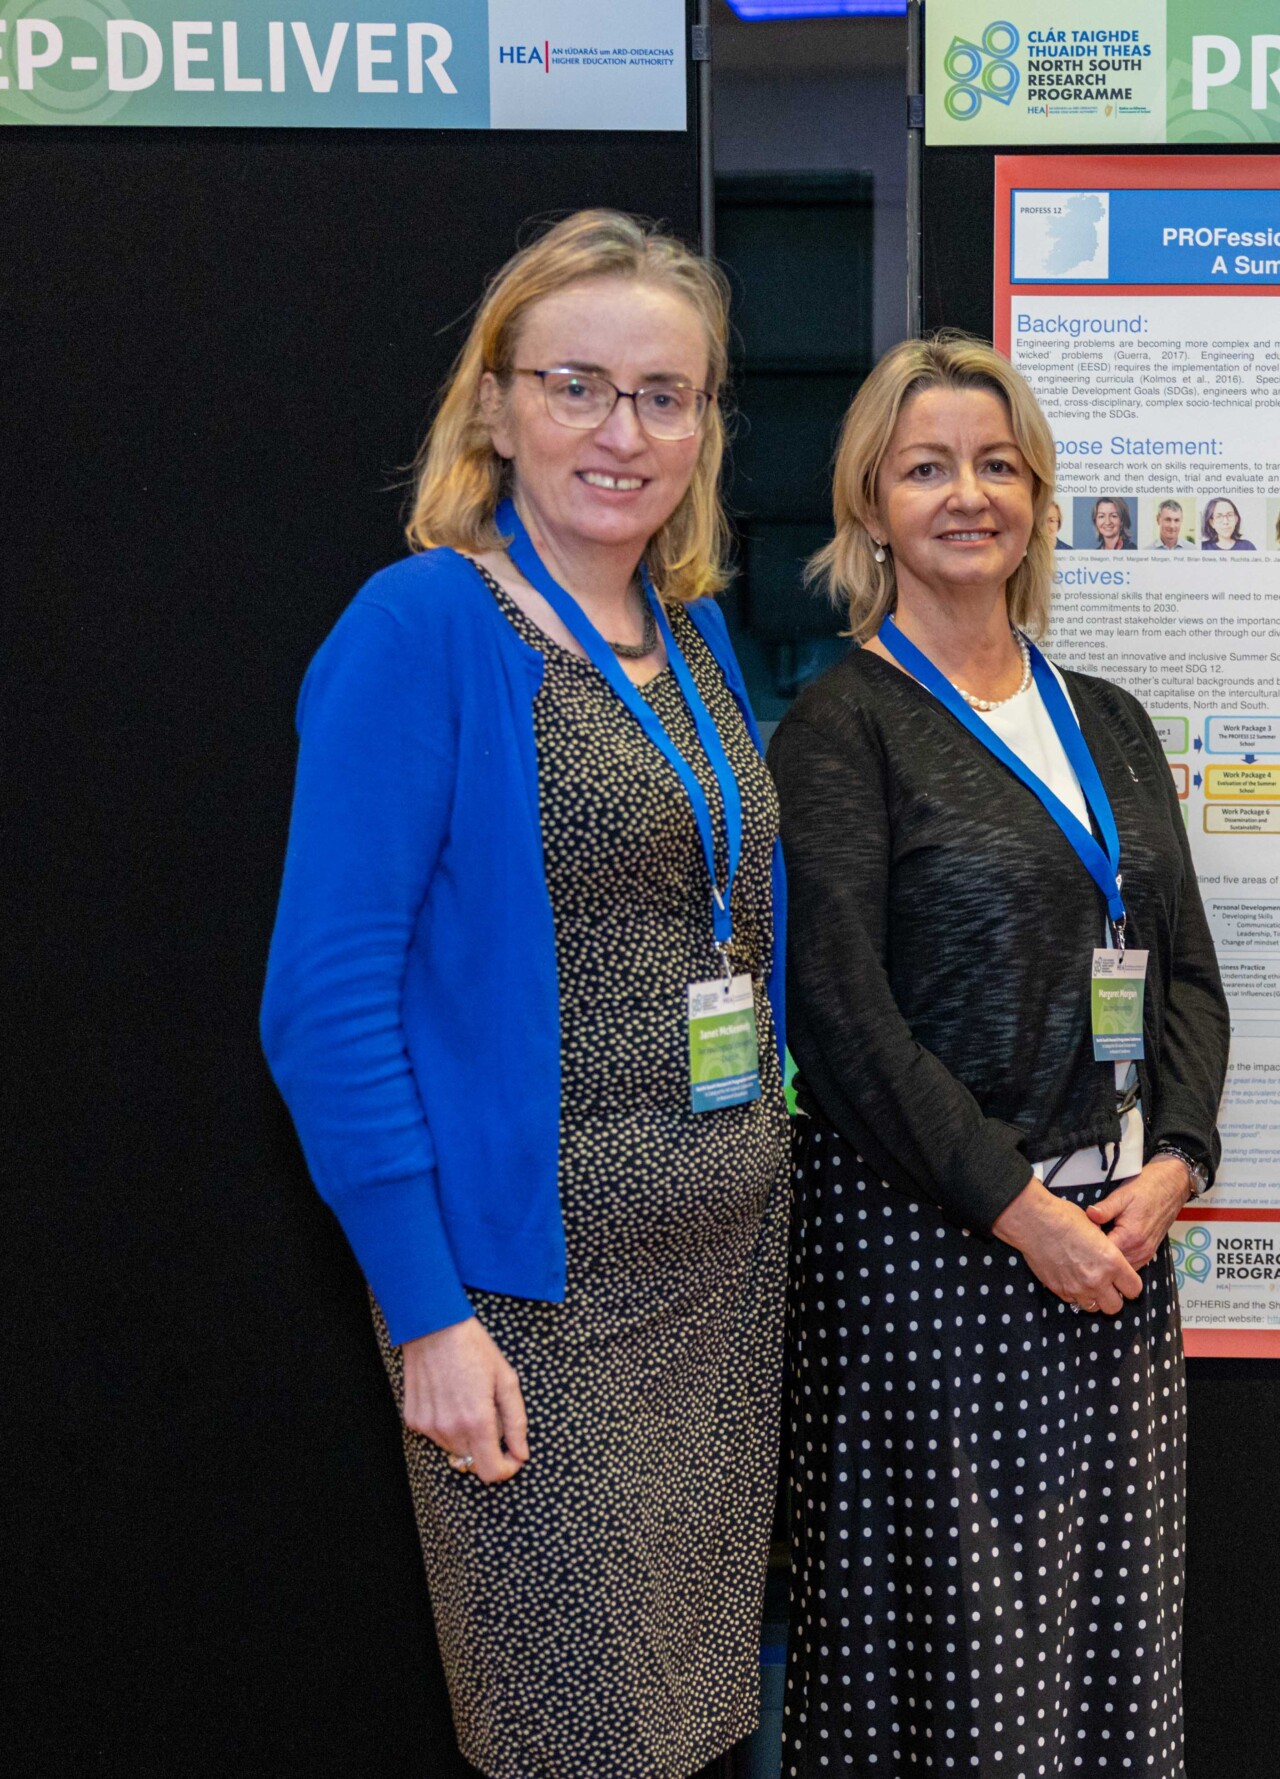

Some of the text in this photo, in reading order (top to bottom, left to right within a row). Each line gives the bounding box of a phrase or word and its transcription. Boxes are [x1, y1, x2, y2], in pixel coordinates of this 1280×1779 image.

[1027, 27, 1139, 42] CLÁR TAIGHDE
[500, 46, 543, 64] HEA
[552, 48, 564, 56] AN
[565, 46, 598, 56] tÚDARÁS
[612, 48, 674, 56] ARD-OIDEACHAS
[1028, 45, 1151, 57] THUAIDH THEAS
[582, 58, 626, 66] EDUCATION
[630, 58, 674, 66] AUTHORITY
[1028, 59, 1141, 71] NORTH SOUTH
[1028, 74, 1105, 86] RESEARCH
[1028, 88, 1131, 100] PROGRAMME
[1027, 106, 1045, 114] HEA
[1212, 256, 1228, 273] A
[1018, 315, 1147, 334] Background:
[1017, 339, 1069, 349] Engineering
[1074, 340, 1115, 349] problems
[1138, 340, 1181, 349] becoming
[1212, 340, 1249, 349] complex
[1254, 340, 1270, 348] and
[1017, 351, 1051, 359] 'wicked'
[1062, 351, 1103, 360] problems
[1114, 351, 1151, 360] (Guerra,
[1162, 351, 1189, 360] 2017).
[1201, 351, 1254, 361] Engineering
[1111, 437, 1222, 455] Statement:
[1190, 463, 1251, 471] requirements,
[1080, 604, 1140, 612] commitments
[1154, 604, 1178, 612] 2030.
[1150, 701, 1268, 709] students, North and South.
[1223, 724, 1240, 732] Work
[1242, 724, 1266, 733] Package
[1217, 1239, 1273, 1250] NORTH
